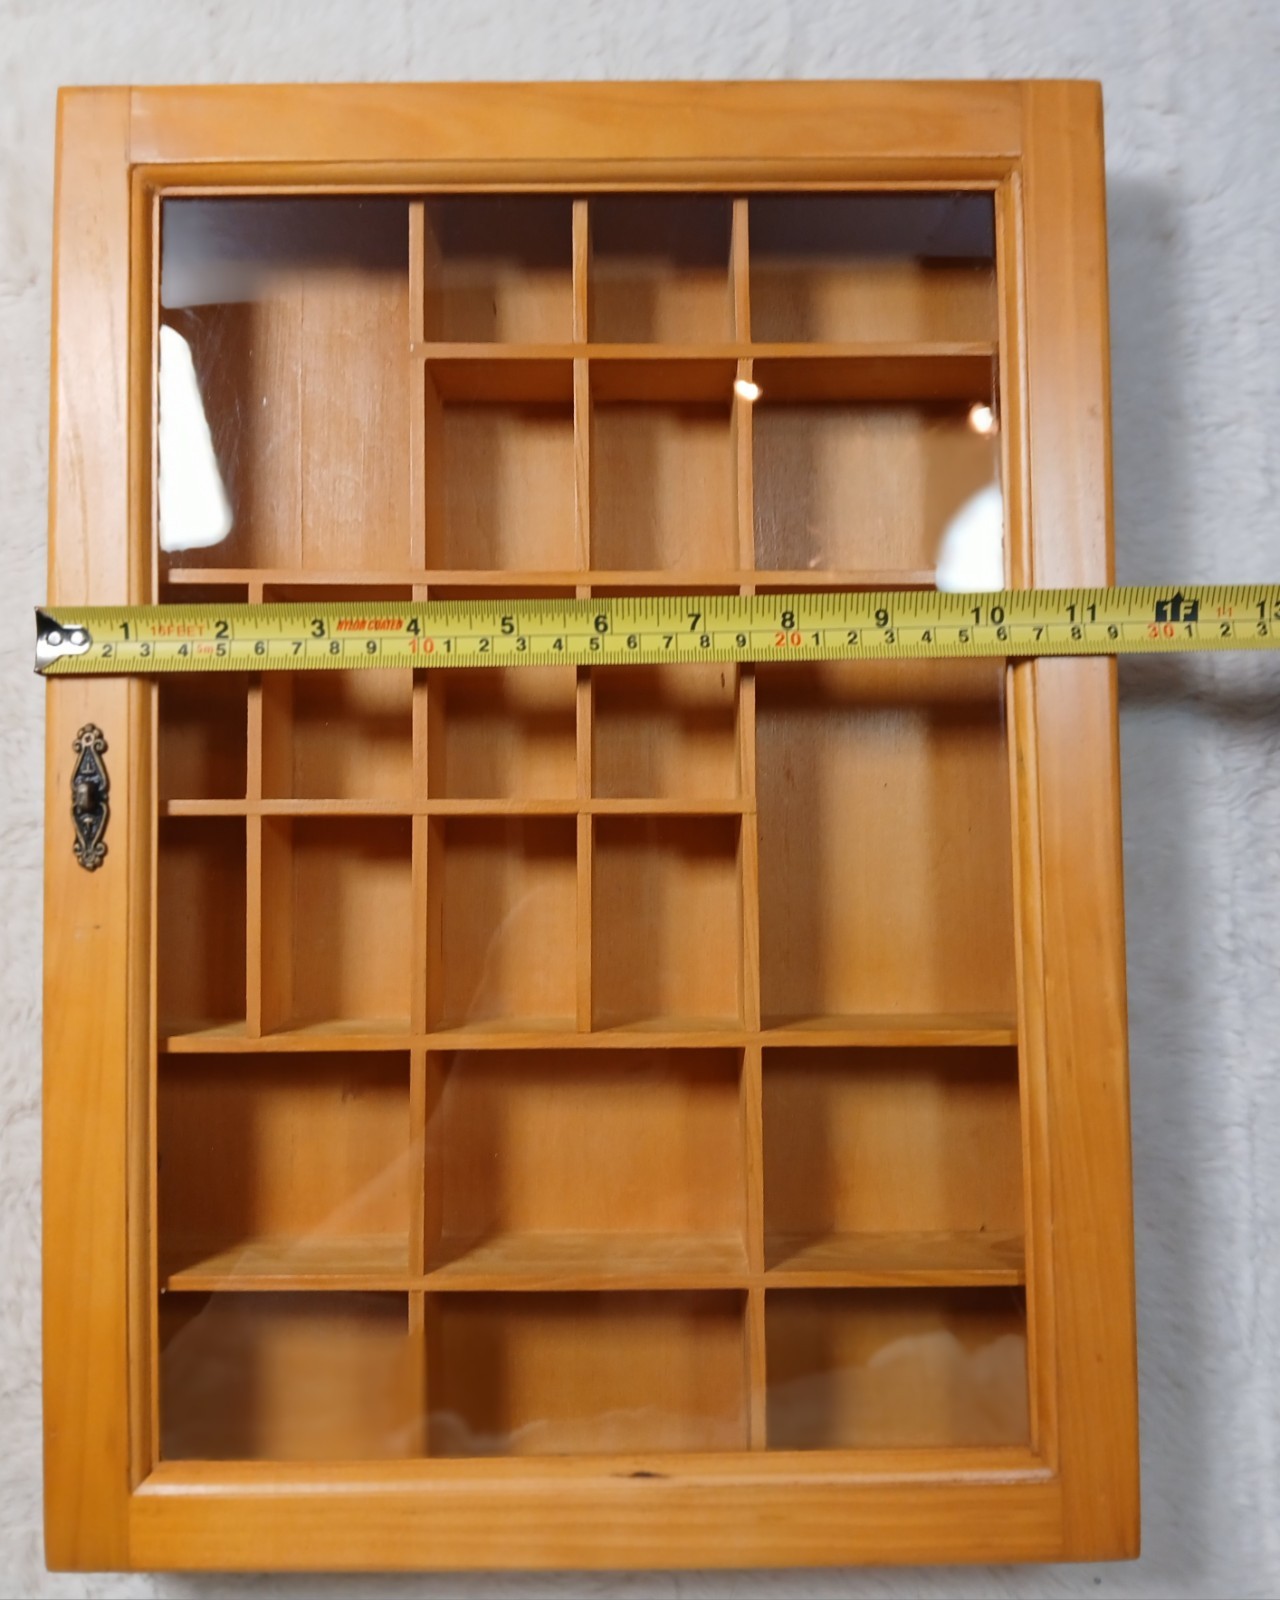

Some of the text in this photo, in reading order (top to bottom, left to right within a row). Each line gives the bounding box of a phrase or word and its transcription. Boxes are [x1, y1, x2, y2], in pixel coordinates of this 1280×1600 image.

[119, 622, 130, 640] 1
[214, 620, 229, 639] 2
[311, 619, 325, 638] 3
[406, 618, 420, 636] 4
[501, 616, 514, 634] 5
[594, 615, 608, 633] 6
[688, 613, 701, 630] 7
[781, 611, 795, 629] 8
[875, 608, 889, 627] 9
[971, 606, 1004, 625] 10
[1066, 603, 1096, 622] 11
[1162, 600, 1195, 622] 1F
[337, 618, 403, 631] NYLON COATED
[101, 621, 1268, 658] 2 3 4 5 6 7 8 9 10 1 2 3 4 5 6 7 8 9 20 1 2 3 4 5 6 7 8 9 30 1 2 3
